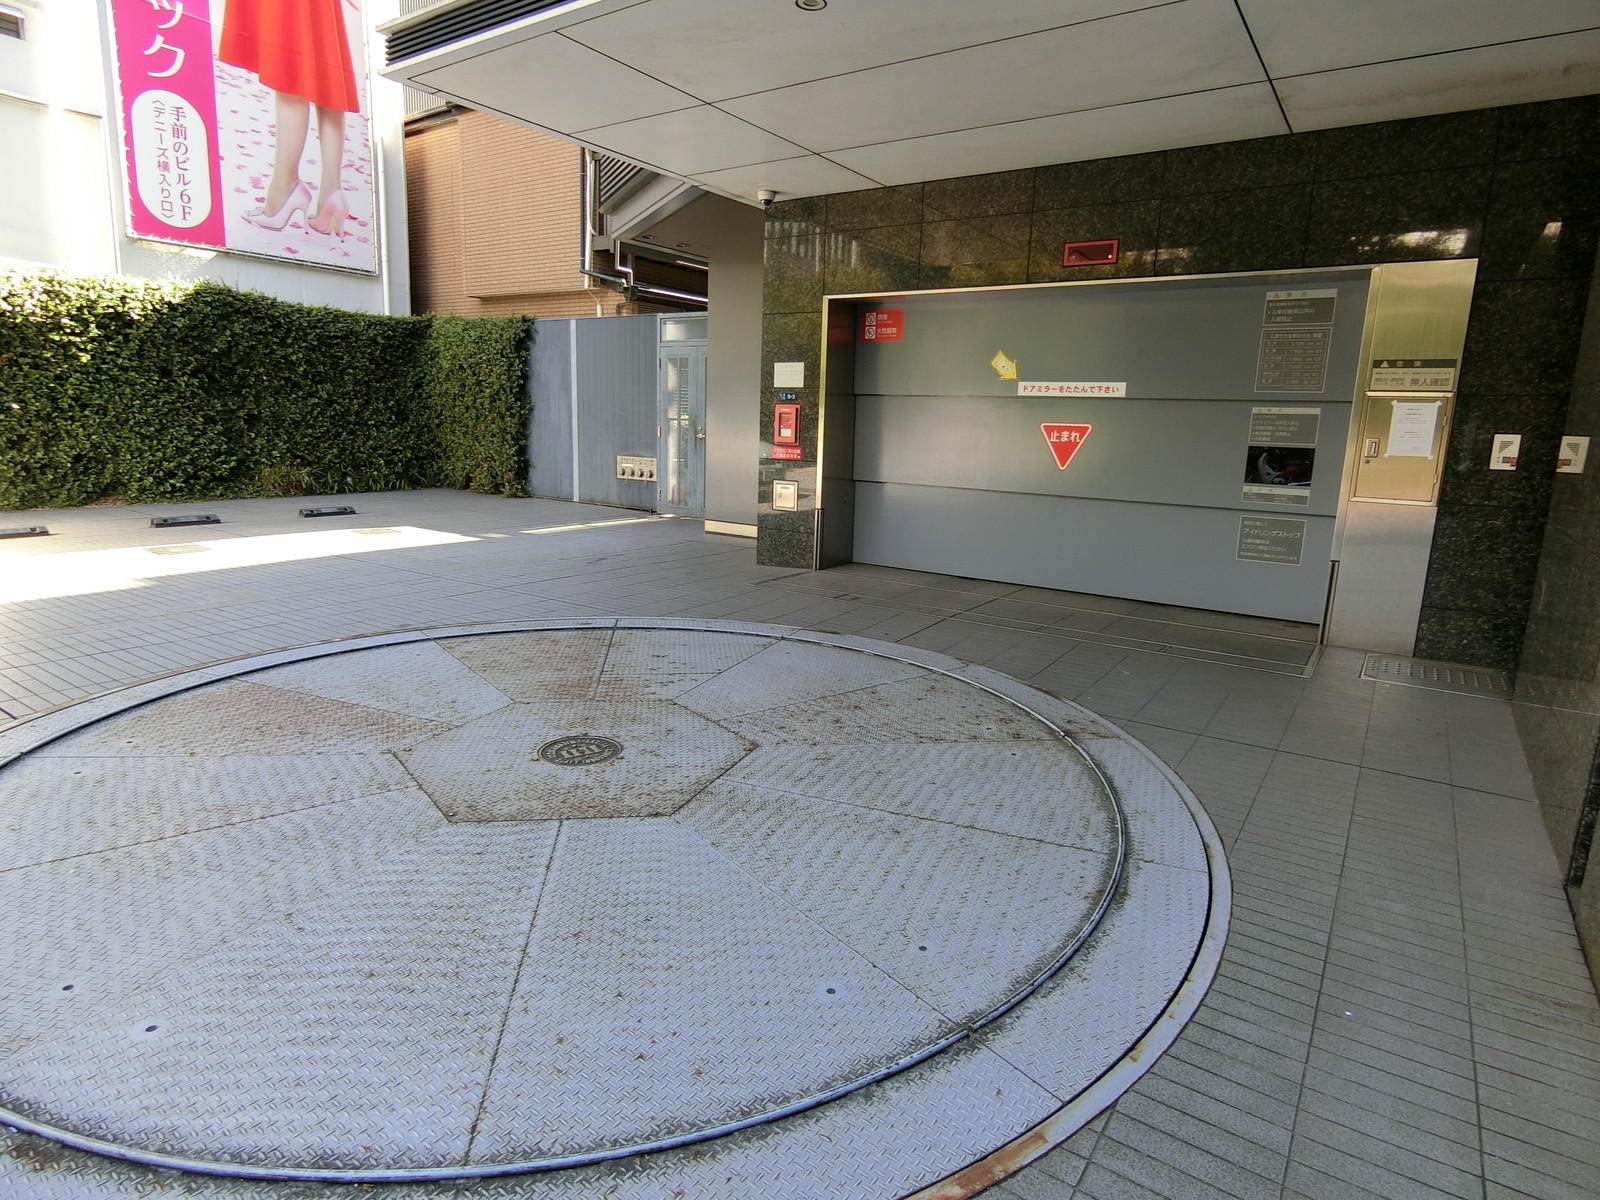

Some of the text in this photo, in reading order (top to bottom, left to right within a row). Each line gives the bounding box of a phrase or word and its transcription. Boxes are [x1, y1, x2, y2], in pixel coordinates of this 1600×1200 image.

[169, 105, 193, 221] 手前のビル6F
[1410, 378, 1450, 387] 無人確認
[1023, 385, 1120, 394] ドアミラーをたたんで下さい
[1050, 430, 1081, 443] 止まれ
[1242, 528, 1302, 539] アイドリングストップ
